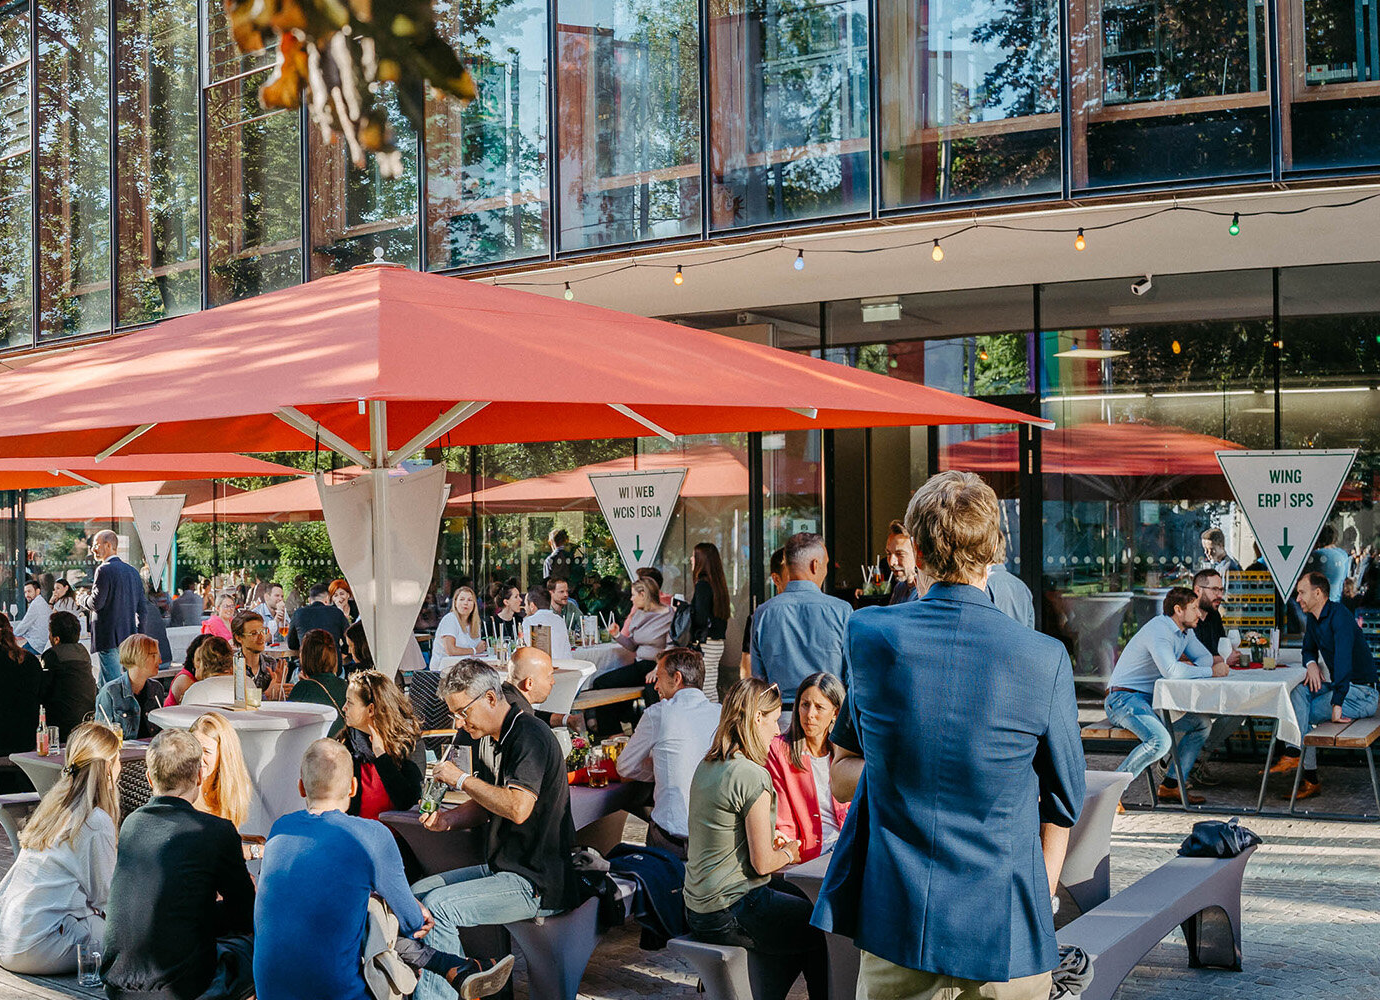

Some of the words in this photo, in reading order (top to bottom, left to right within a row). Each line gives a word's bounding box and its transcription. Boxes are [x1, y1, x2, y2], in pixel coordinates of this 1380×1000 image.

[1269, 469, 1302, 483] WING
[619, 487, 629, 499] WI
[635, 485, 654, 498] WEB
[1258, 493, 1281, 507] ERP
[1290, 493, 1313, 507] SPS
[613, 506, 635, 518] WCIS
[641, 505, 661, 518] DSIA
